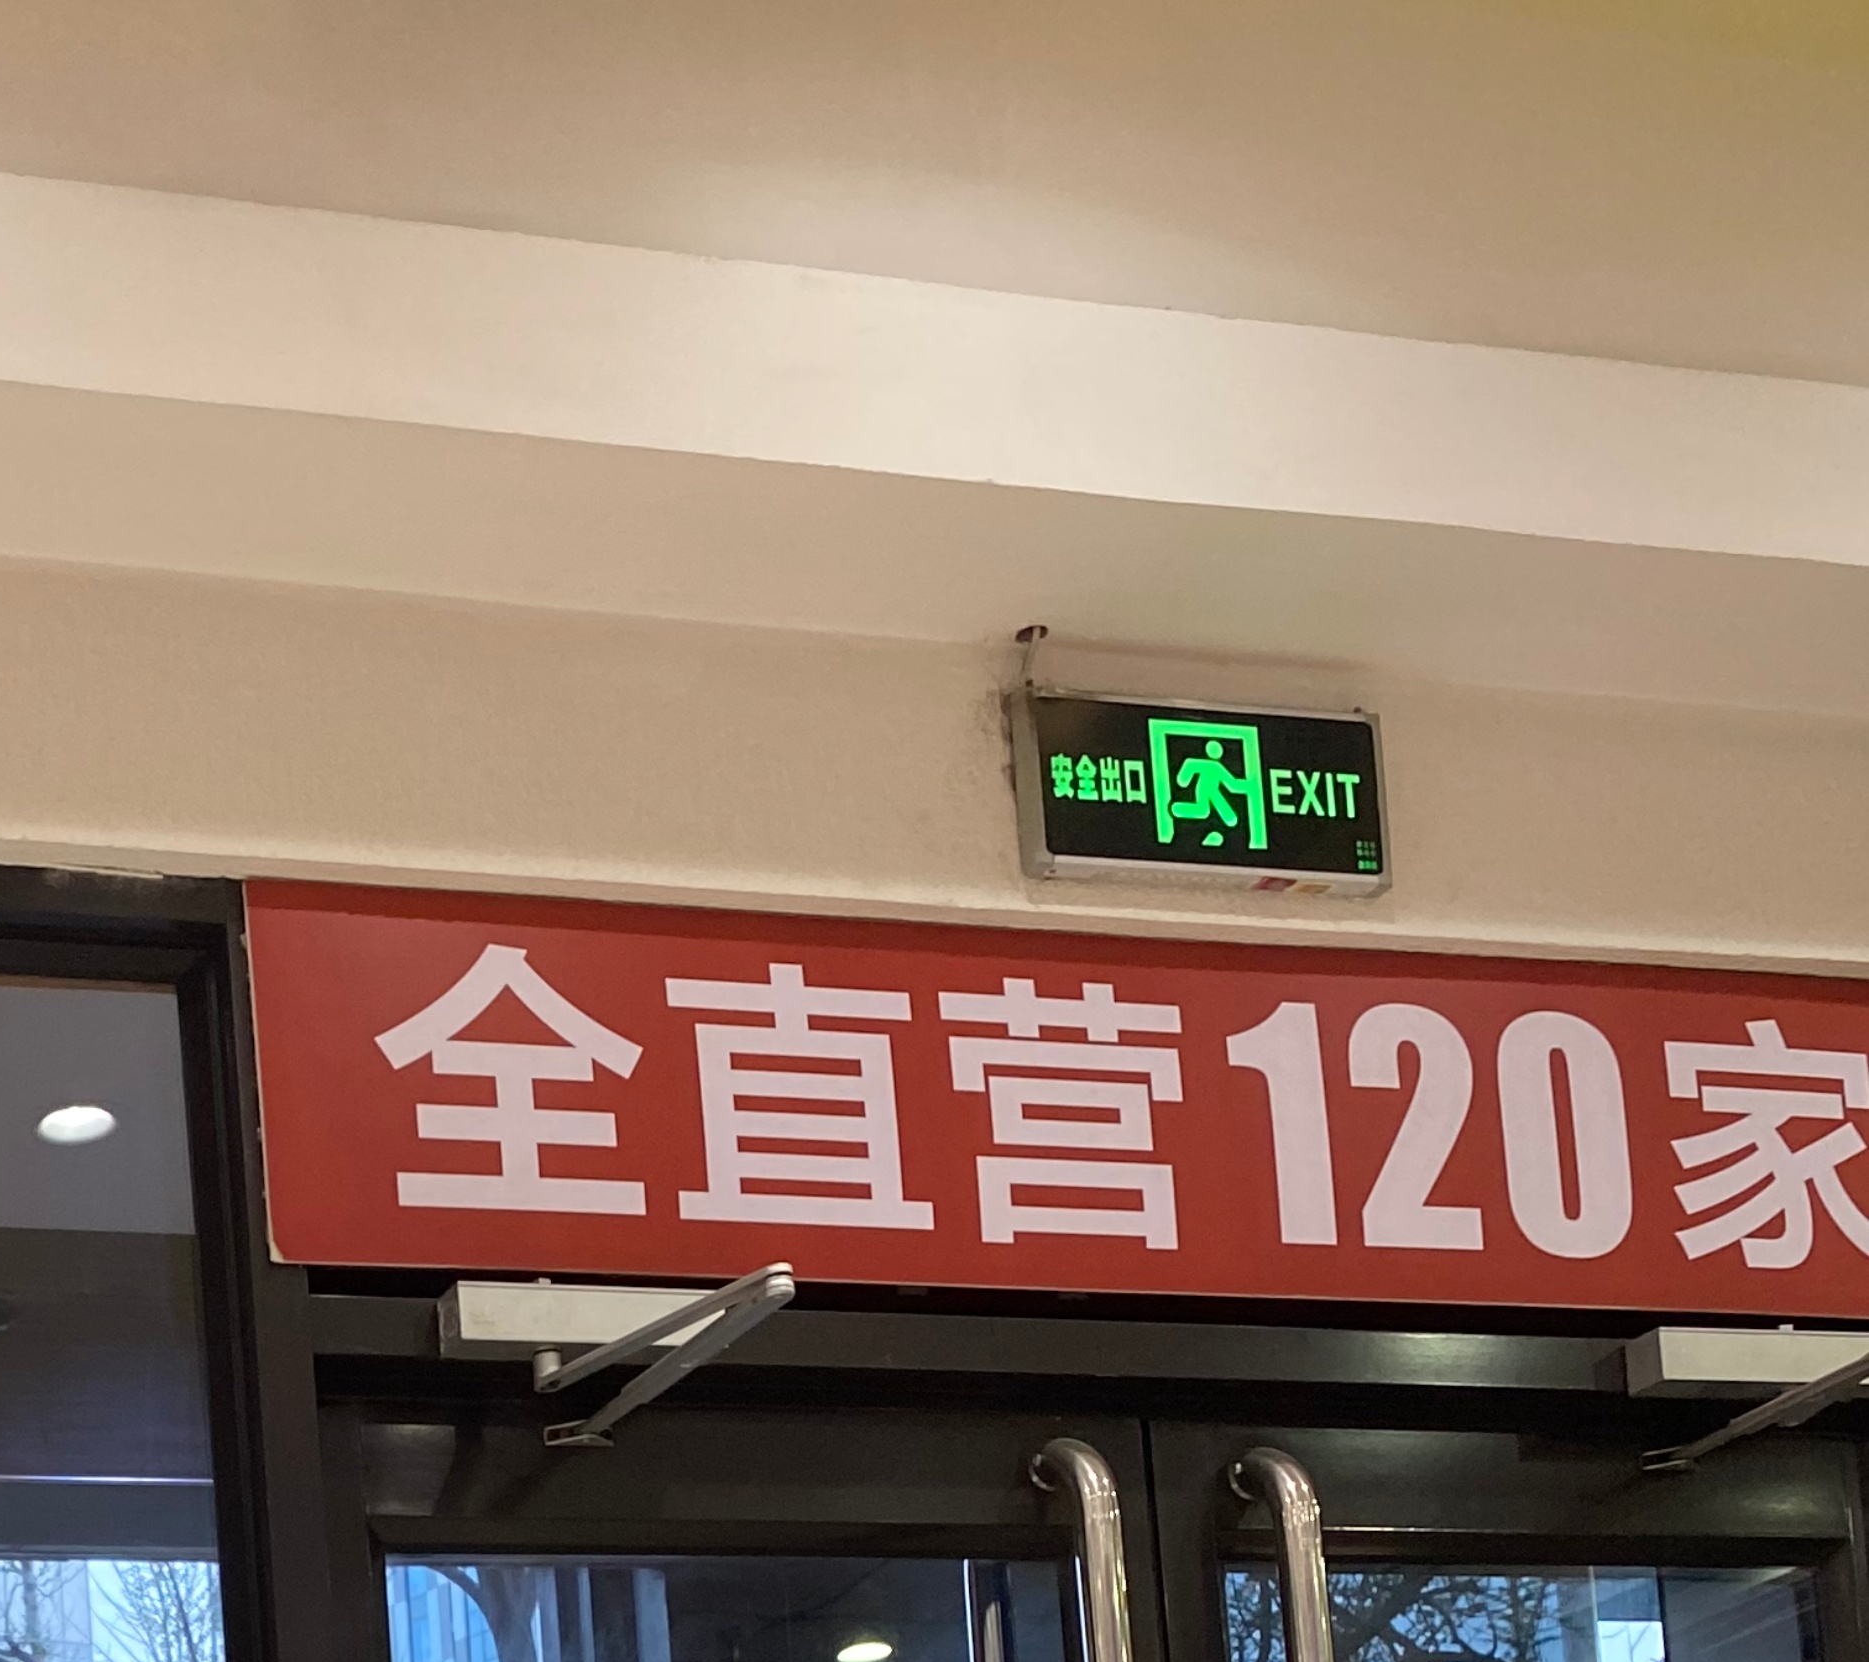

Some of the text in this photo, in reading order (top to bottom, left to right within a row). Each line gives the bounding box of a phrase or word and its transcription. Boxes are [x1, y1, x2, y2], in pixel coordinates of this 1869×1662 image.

[1049, 753, 1148, 804] 安全出口
[1269, 768, 1361, 819] EXIT
[374, 943, 1869, 1270] 全直营120家
